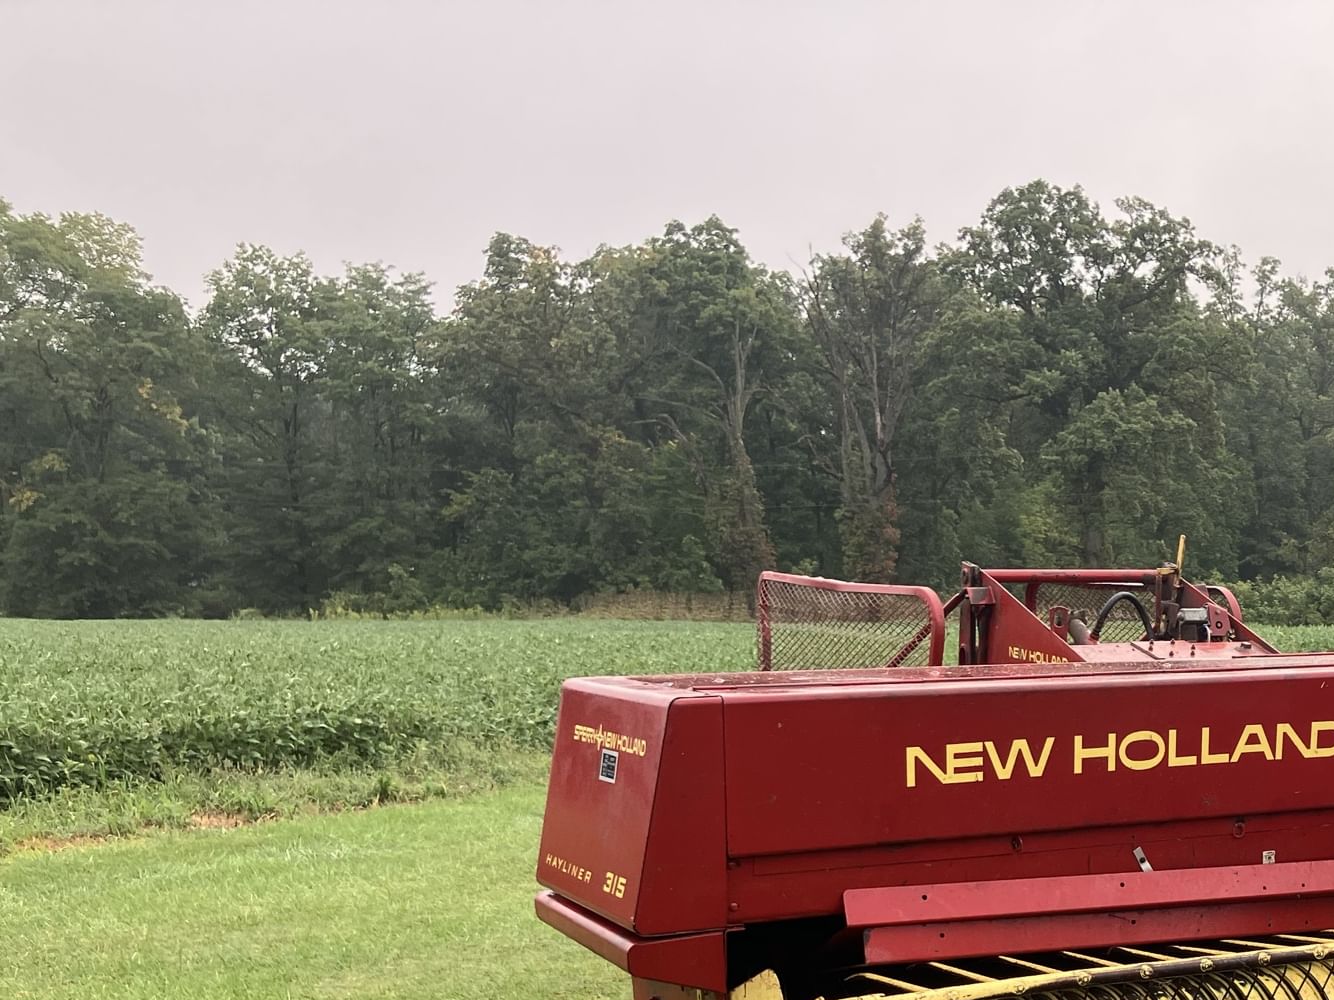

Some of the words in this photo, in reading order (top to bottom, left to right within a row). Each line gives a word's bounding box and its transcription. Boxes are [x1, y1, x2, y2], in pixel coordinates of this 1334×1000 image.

[1008, 646, 1027, 660] NEW
[616, 734, 647, 757] HOLLAND
[906, 737, 1055, 788] NEW
[546, 853, 592, 884] HAYLINER
[602, 871, 627, 899] 315
